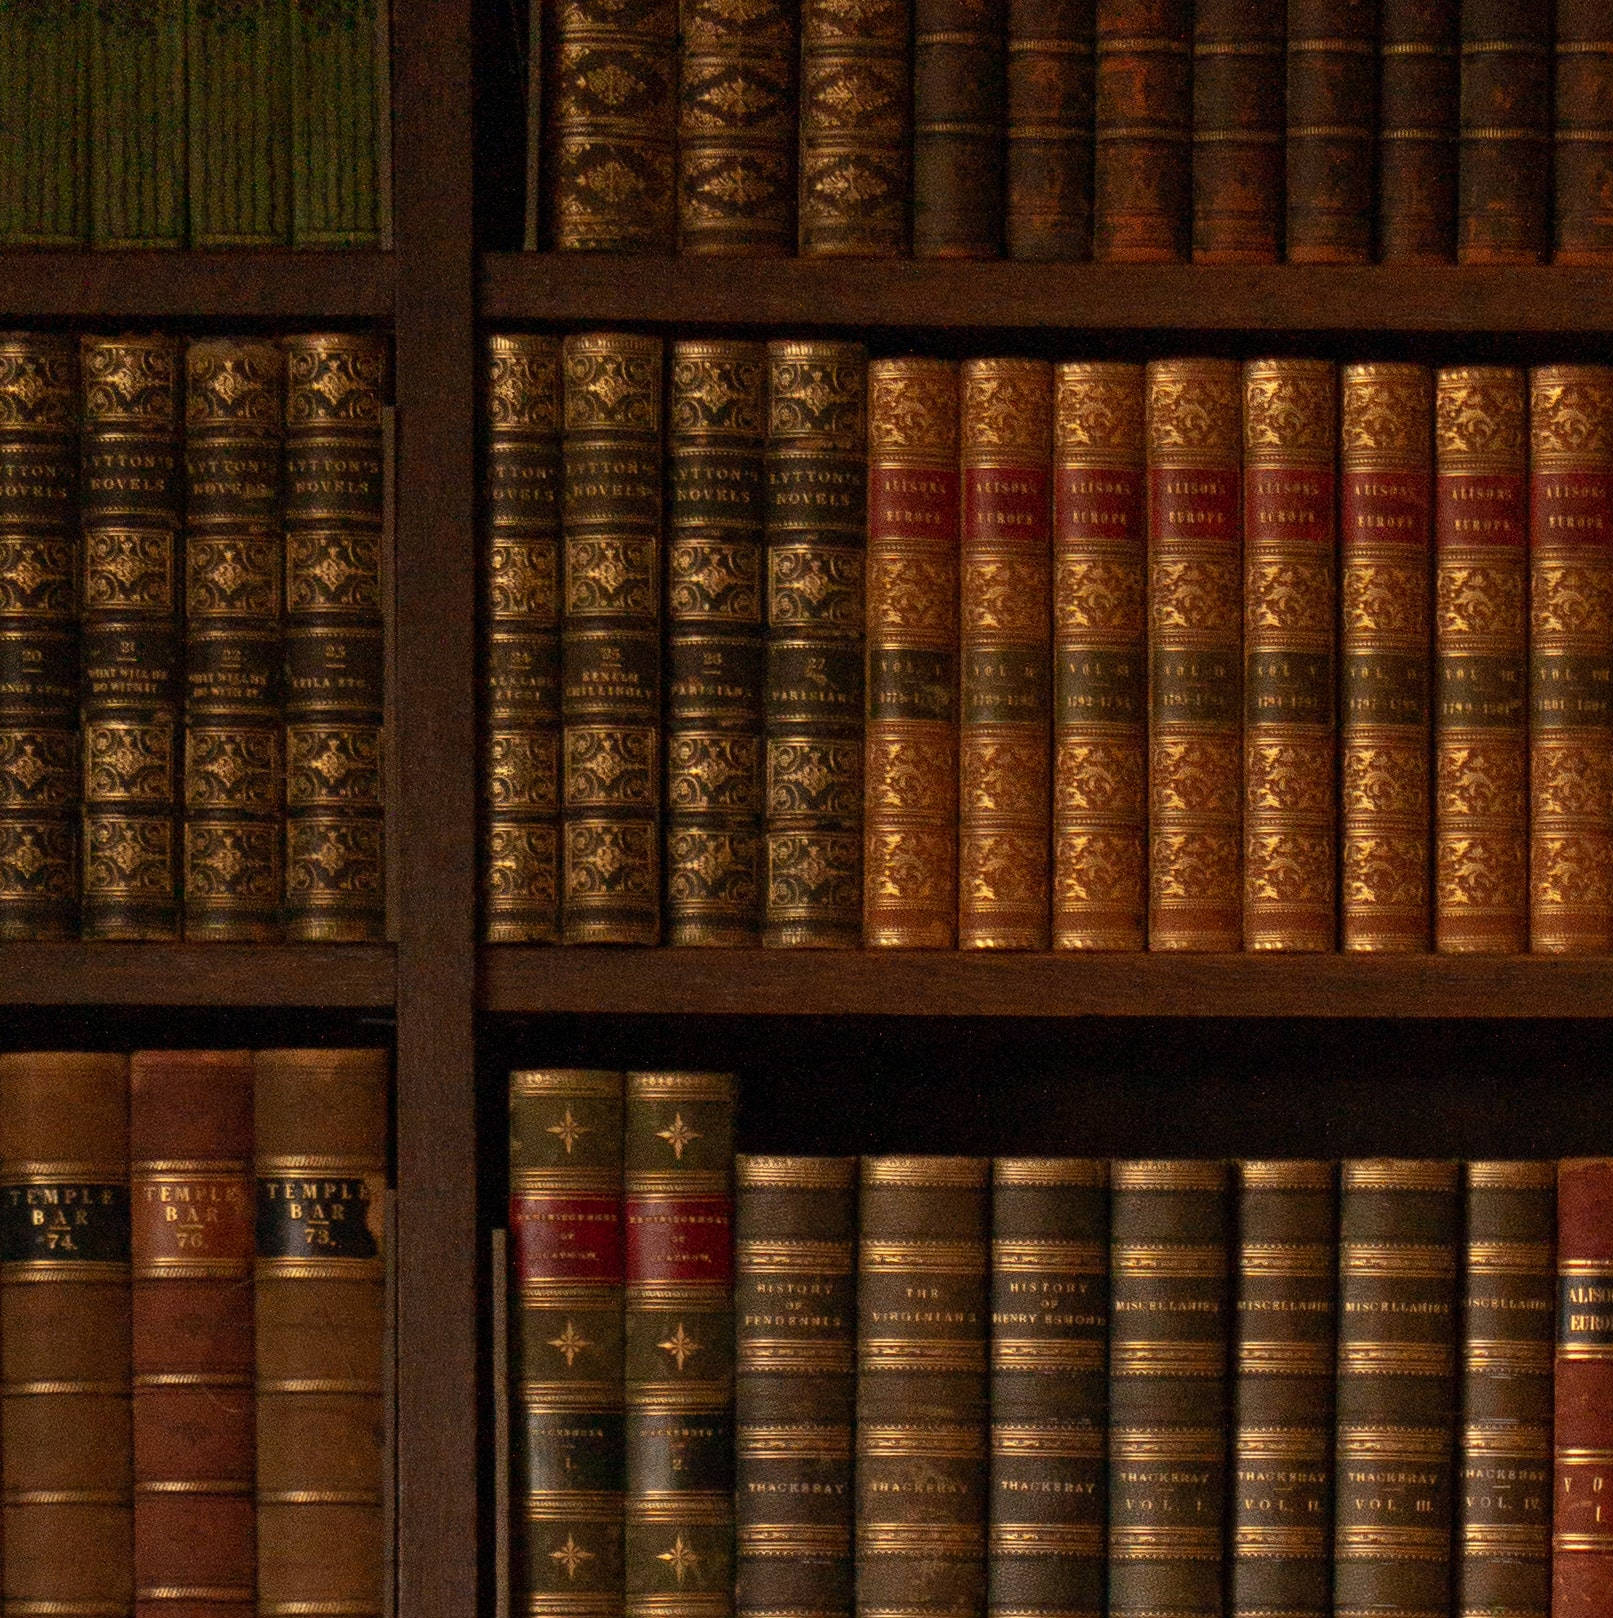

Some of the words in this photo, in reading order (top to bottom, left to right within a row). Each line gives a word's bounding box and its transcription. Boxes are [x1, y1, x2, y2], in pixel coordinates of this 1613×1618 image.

[9, 1190, 118, 1205] TEMPLE
[147, 1187, 242, 1202] TEMPLE
[32, 1209, 88, 1226] BAR
[166, 1207, 219, 1222] BAR
[290, 1204, 345, 1220] BAR
[756, 1284, 833, 1294] HISTORY
[907, 1288, 939, 1299] THE
[1010, 1283, 1087, 1294] HISTORY
[787, 1302, 802, 1310] OF
[1040, 1300, 1058, 1308] OF
[873, 1313, 976, 1323] VIRGINIANS
[993, 1314, 1036, 1325] HENRY
[1350, 1473, 1437, 1484] THACKERAY
[750, 1483, 844, 1495] THACKERAY
[1001, 1482, 1094, 1494] THACKERAY
